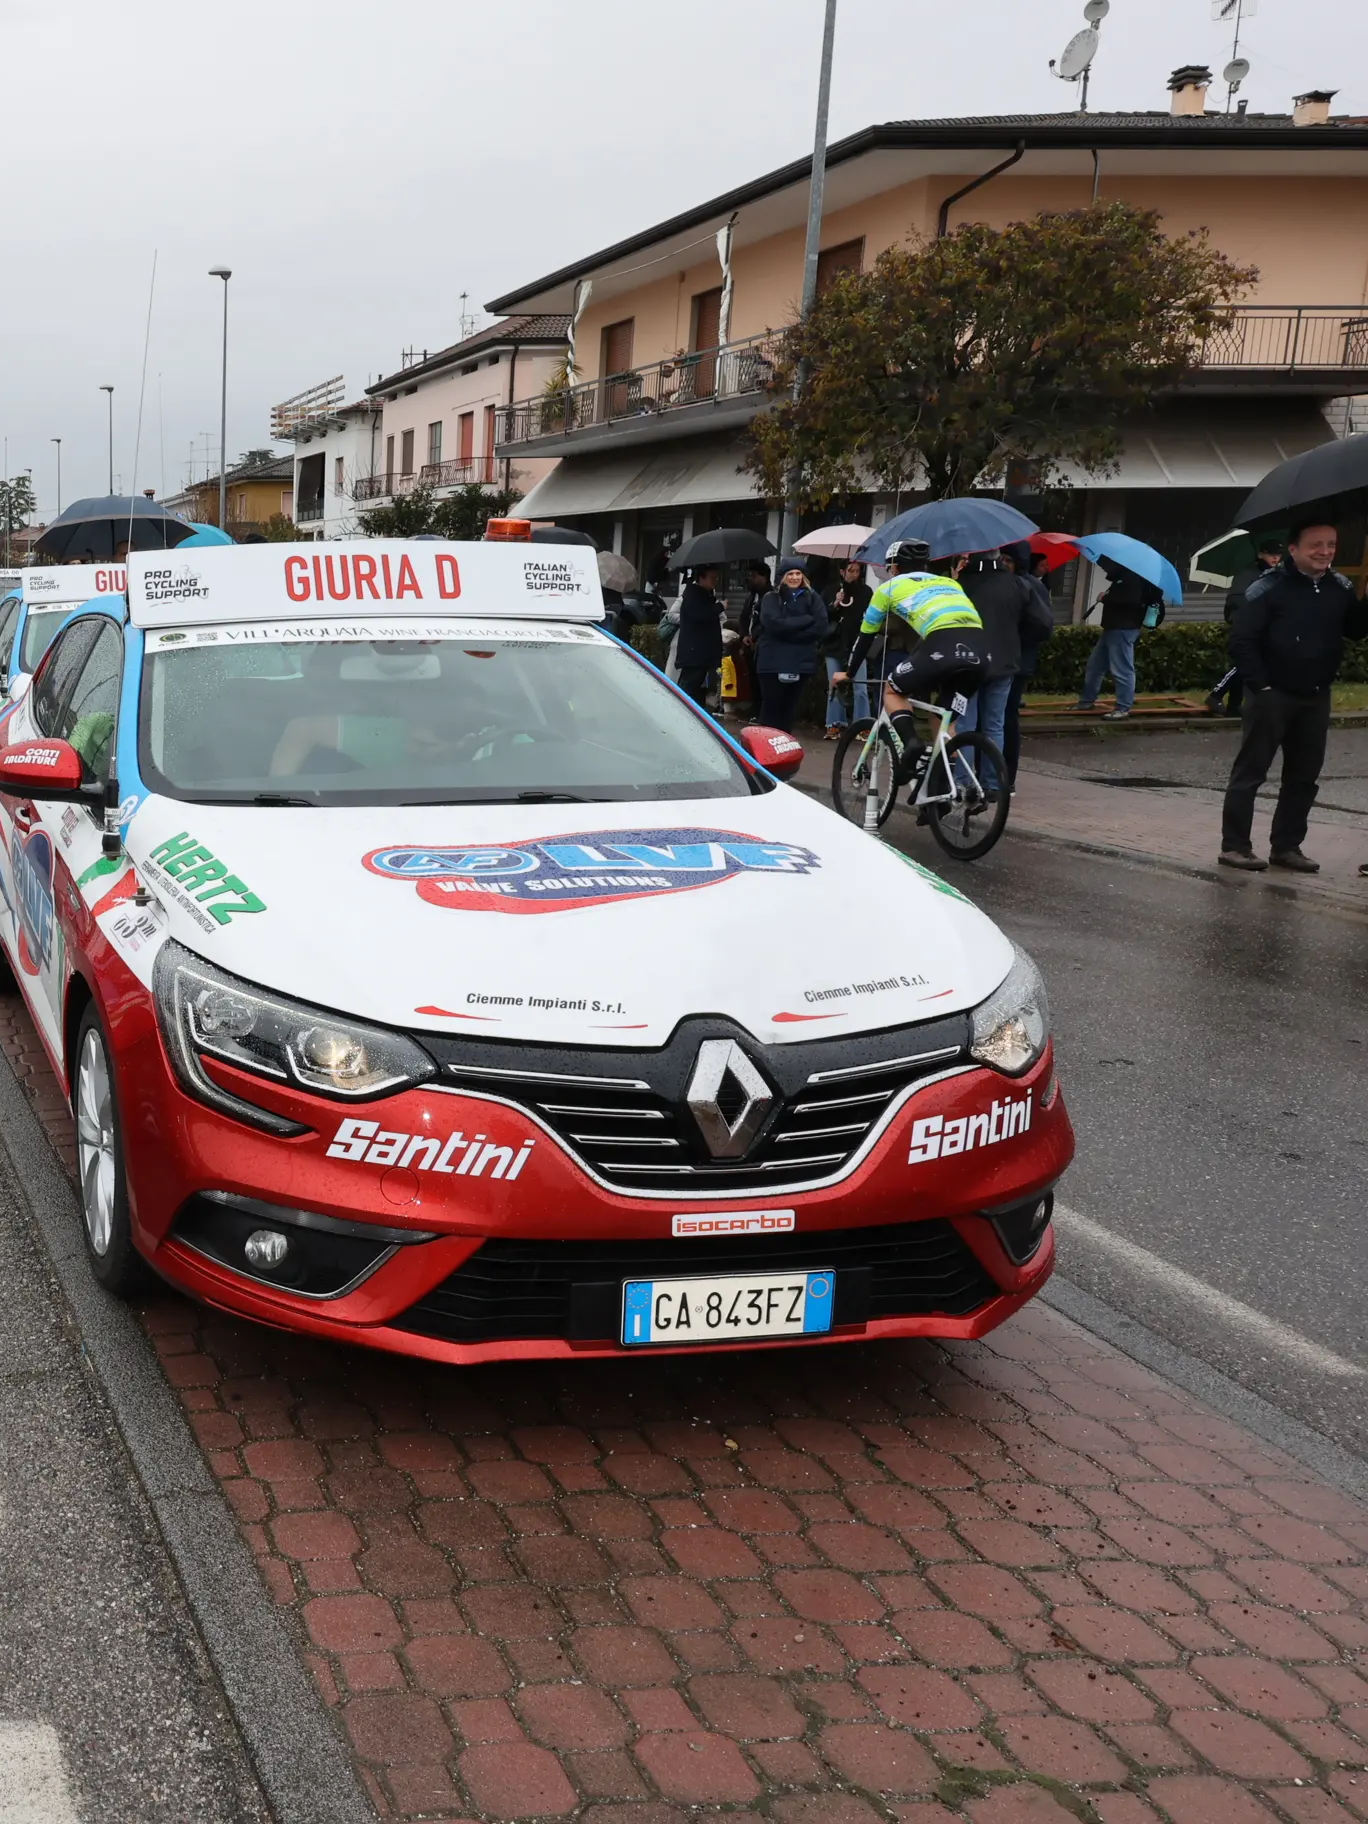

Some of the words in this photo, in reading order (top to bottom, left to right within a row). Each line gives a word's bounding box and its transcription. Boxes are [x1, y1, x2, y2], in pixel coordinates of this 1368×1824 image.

[523, 562, 567, 572] ITALIAN
[144, 570, 172, 580] PRO
[284, 554, 423, 602] GIURIA
[435, 554, 461, 599] D
[525, 572, 571, 582] CYCLING
[145, 579, 198, 590] CYCLING
[526, 582, 582, 592] SUPPORT
[146, 588, 209, 600] SUPPORT
[378, 628, 423, 636] WINE
[425, 627, 545, 638] FRANCIACORTA
[26, 748, 60, 758] CONTI
[3, 755, 57, 767] SALDATURE
[541, 842, 808, 873] LVF
[149, 831, 268, 926] HERTZ
[434, 880, 518, 893] VALVE
[524, 876, 673, 891] SOLUTIONS
[804, 986, 852, 1002] Ciemme
[852, 977, 900, 994] Impianti
[900, 974, 929, 987] S.r.l.
[466, 993, 524, 1006] Ciemme
[528, 996, 587, 1010] Impianti
[591, 1000, 627, 1014] S.r.l.
[907, 1088, 1033, 1165] Santini
[325, 1117, 537, 1181] Santini
[676, 1214, 793, 1233] isocarbo
